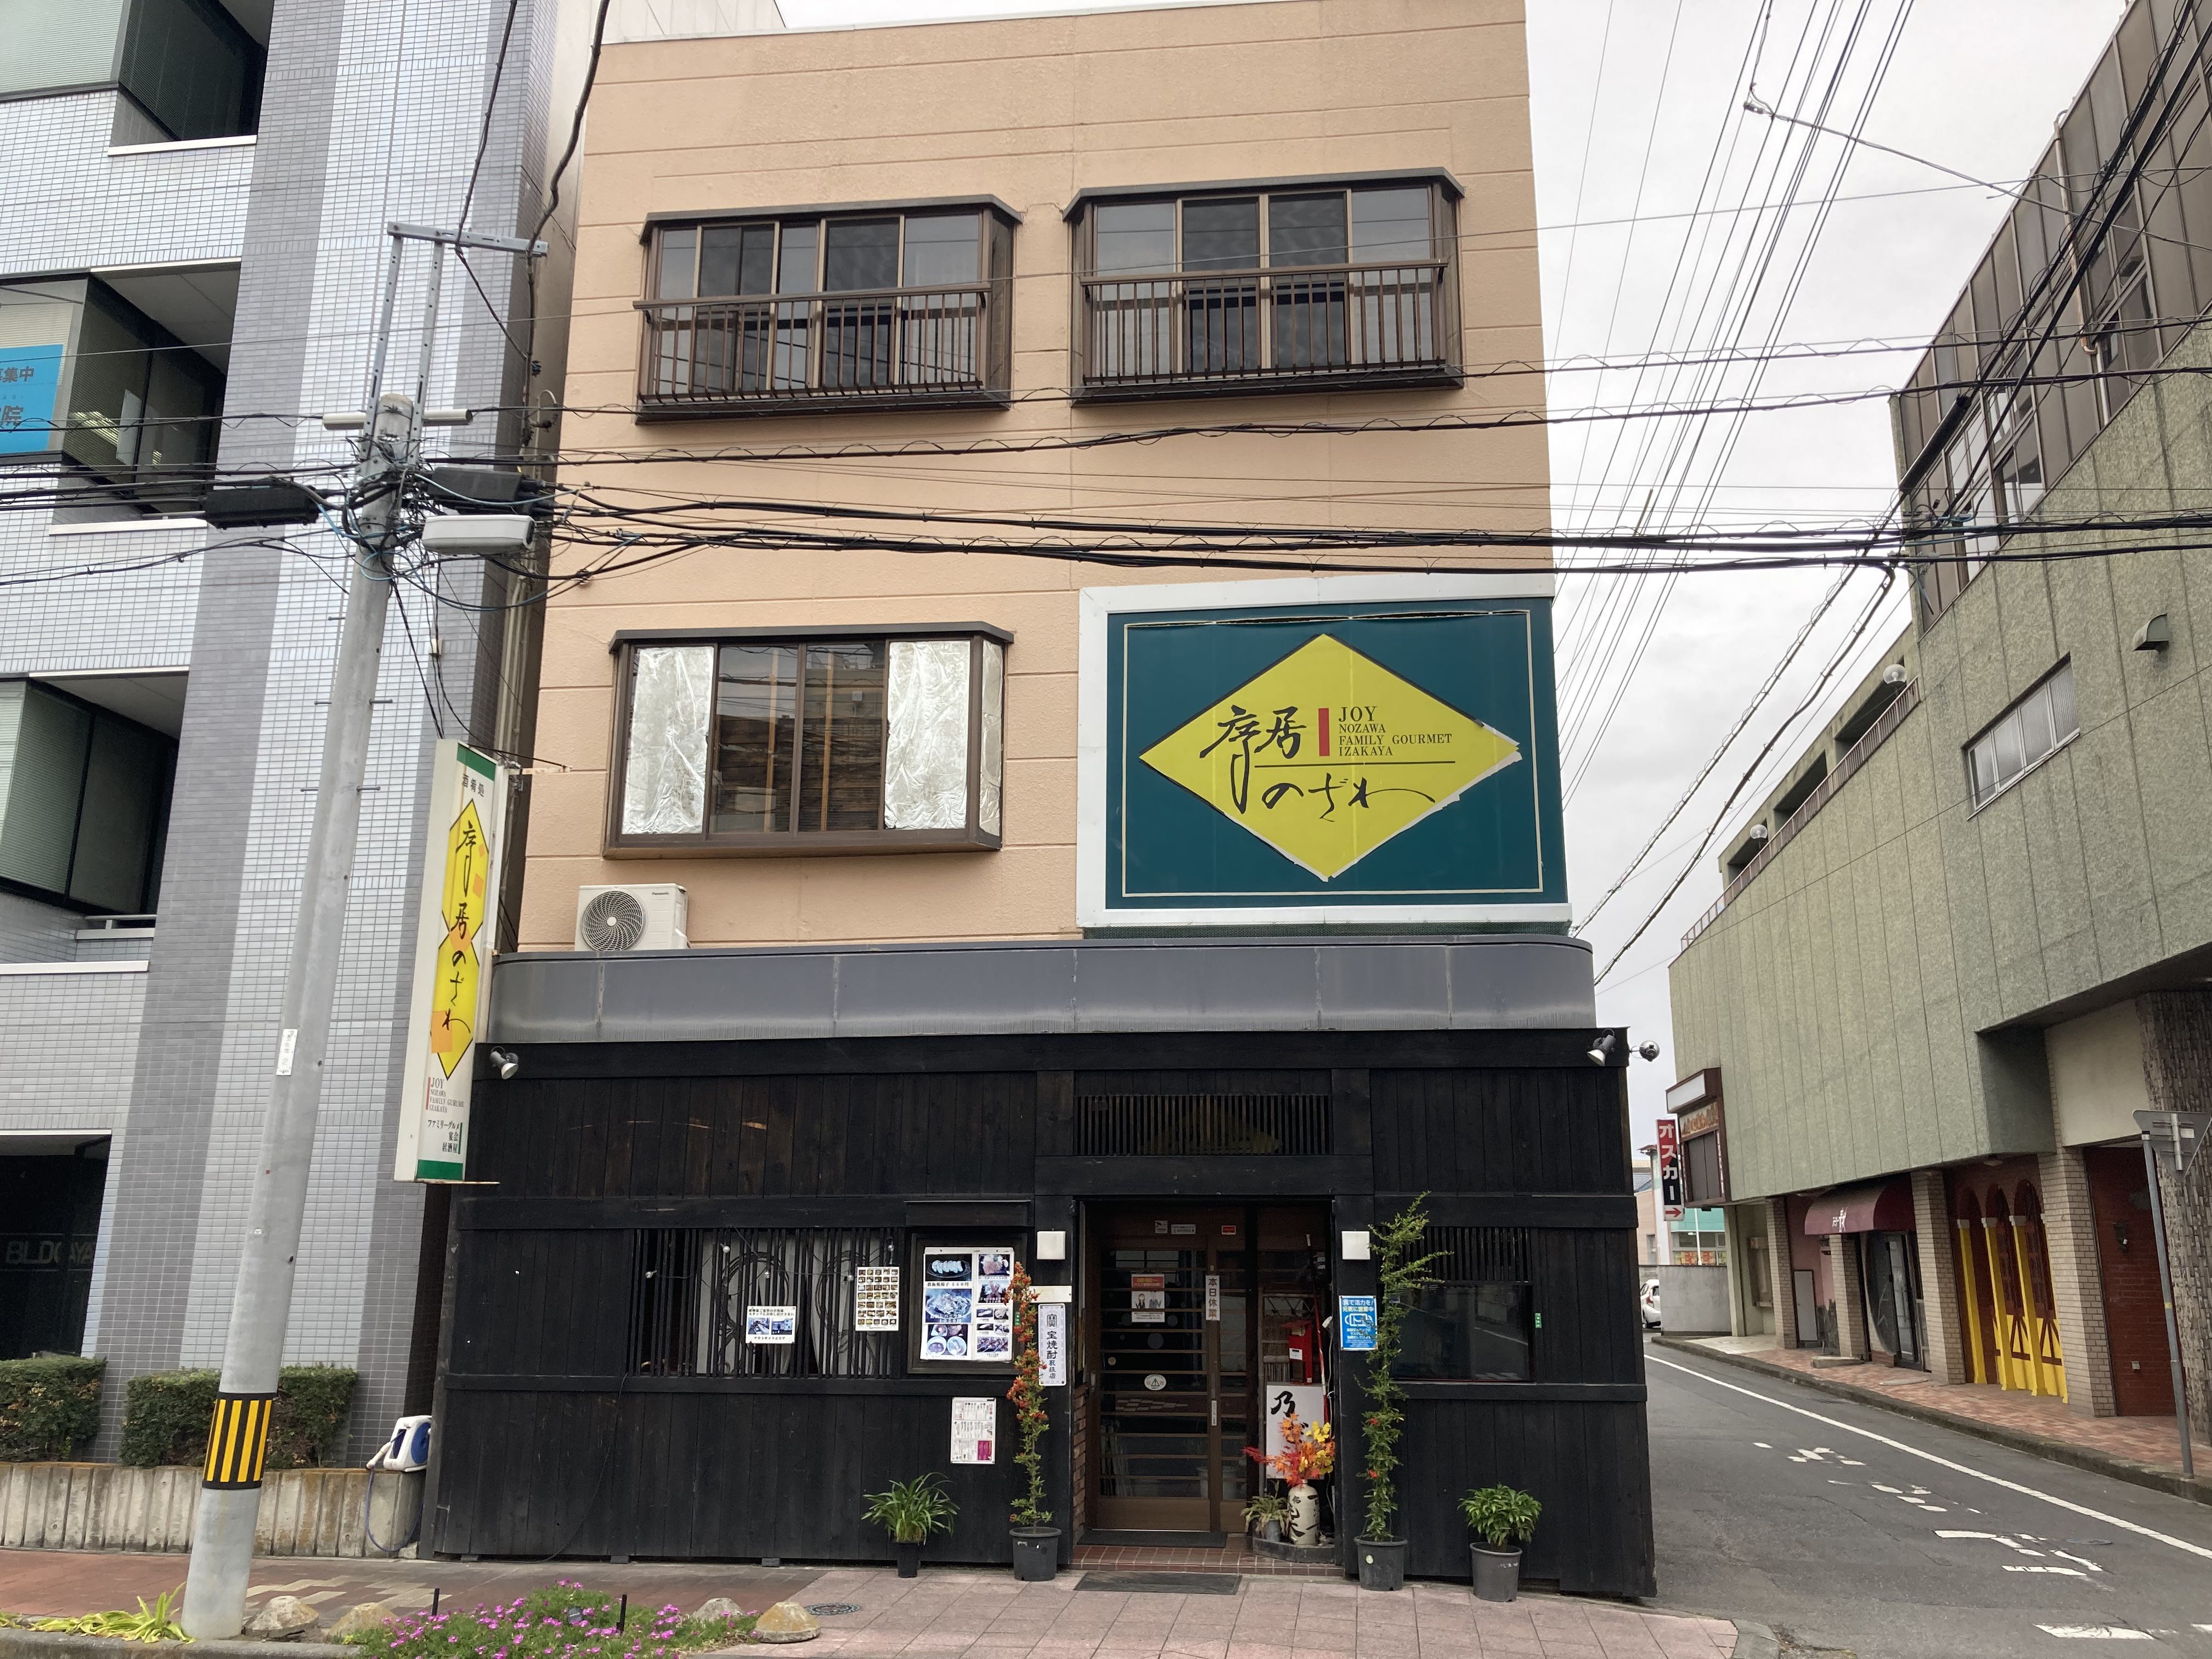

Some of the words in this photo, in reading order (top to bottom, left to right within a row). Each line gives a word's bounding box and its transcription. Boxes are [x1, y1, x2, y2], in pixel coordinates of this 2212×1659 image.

[0, 405, 24, 426] 院
[1338, 706, 1378, 722] JOY
[1339, 723, 1386, 734] NOZAWA
[1339, 735, 1384, 746] FAMILY
[1392, 733, 1452, 745] GOURMET
[1339, 746, 1393, 757] IZAKAYA
[462, 774, 484, 797] 酒肴処
[1261, 772, 1435, 822] のざわ
[431, 1077, 444, 1090] JOY
[430, 1089, 446, 1097] NOZAWA
[430, 1097, 446, 1105] FAMILY
[429, 1104, 447, 1113] IZAKAYA
[427, 1120, 460, 1130] ファミリーグルメ
[449, 1132, 459, 1142] 宴会
[442, 1142, 458, 1153] 居酒屋
[1658, 1124, 1678, 1200] オスカー
[1208, 1277, 1217, 1318] 本日休業
